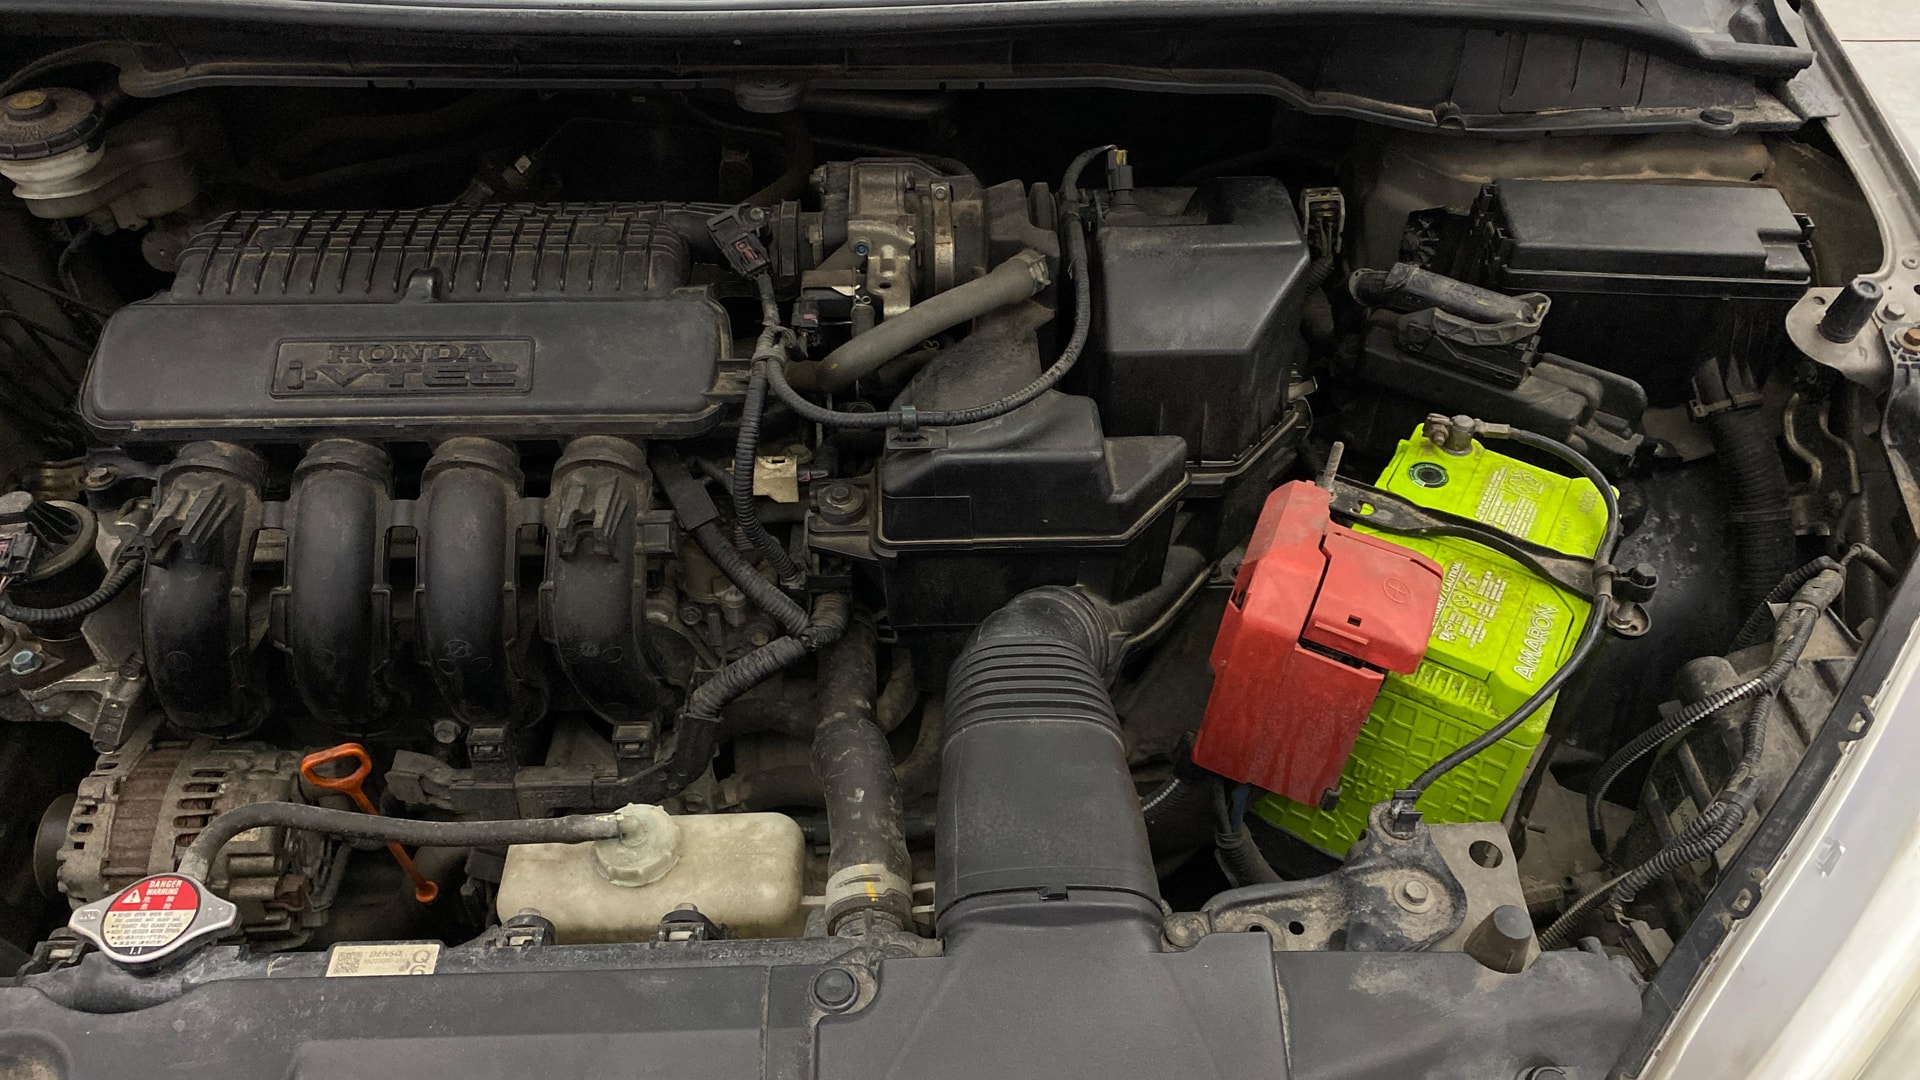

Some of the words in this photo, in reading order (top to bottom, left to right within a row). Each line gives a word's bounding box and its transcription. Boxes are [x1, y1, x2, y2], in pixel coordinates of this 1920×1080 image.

[327, 343, 492, 364] HONDA
[1445, 562, 1463, 592] CAUTION
[1513, 602, 1559, 681] AMARON
[149, 880, 182, 888] DANGER
